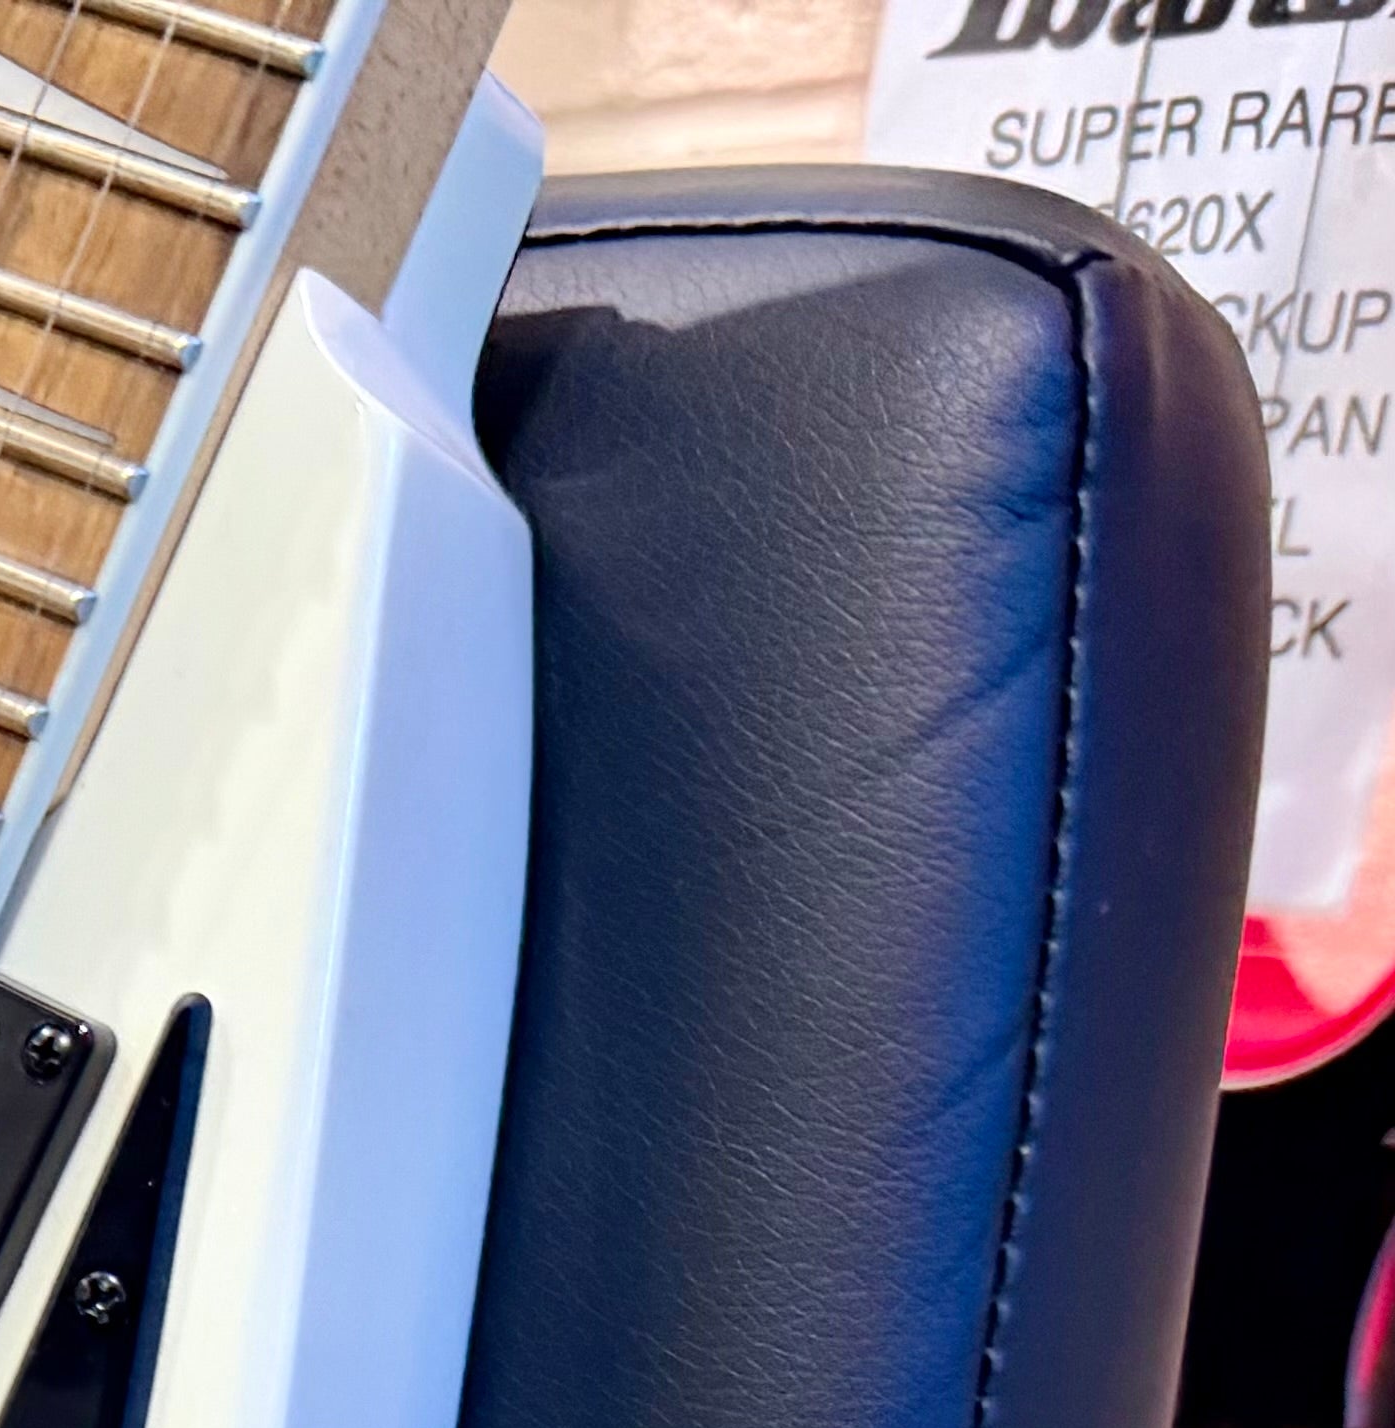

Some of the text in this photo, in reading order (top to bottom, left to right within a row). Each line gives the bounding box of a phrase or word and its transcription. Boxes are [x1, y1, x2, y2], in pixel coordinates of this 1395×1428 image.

[986, 82, 1395, 170] SUPER RARE
[1094, 190, 1274, 256] 620X
[1258, 392, 1390, 457] PAN
